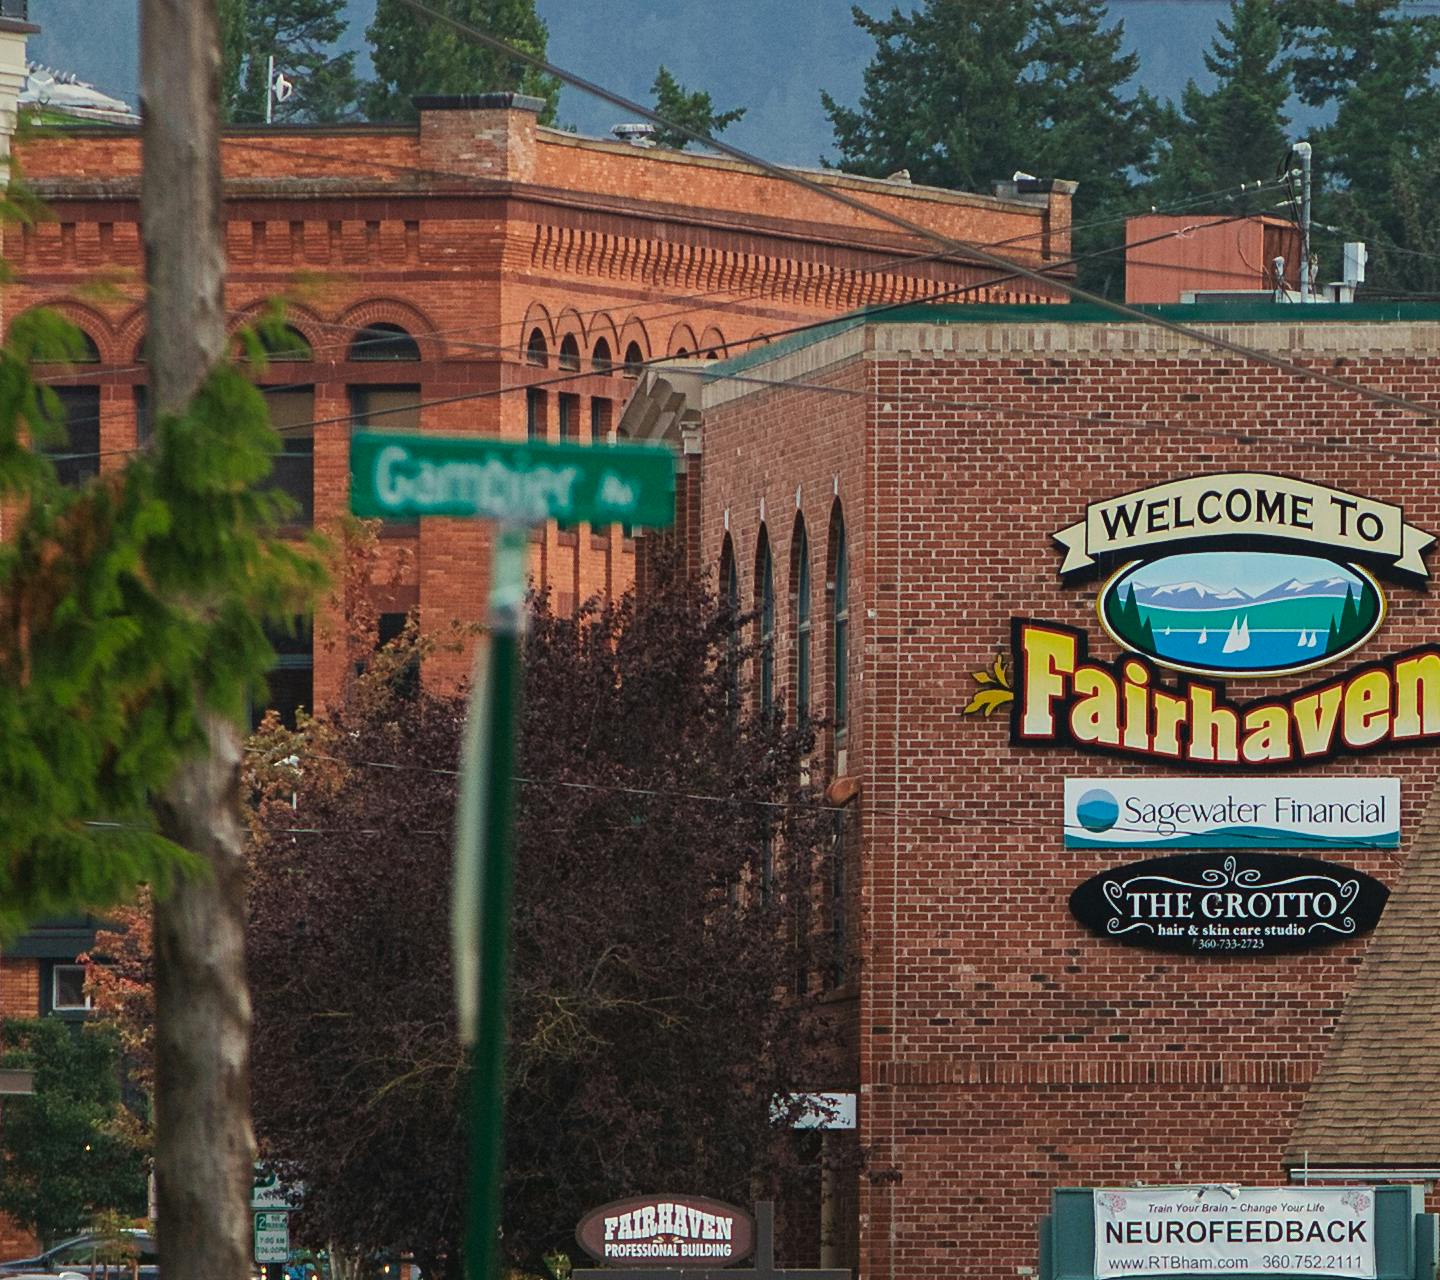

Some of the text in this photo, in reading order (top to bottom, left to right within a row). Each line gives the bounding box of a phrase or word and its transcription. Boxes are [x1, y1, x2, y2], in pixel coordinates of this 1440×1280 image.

[1100, 487, 1384, 542] WELCOME TO
[1125, 795, 1386, 836] Sagewater Financial
[1126, 892, 1337, 919] THE GROTTO
[1157, 924, 1306, 936] hair & skin care studio
[1198, 938, 1265, 949] 360-733-2723
[1148, 1203, 1173, 1213] Train
[1176, 1203, 1199, 1213] Your
[1202, 1203, 1228, 1213] Brain
[1240, 1203, 1278, 1215] Change
[1280, 1203, 1305, 1213] Your
[1306, 1203, 1325, 1213] Life
[604, 1202, 733, 1241] FAIRHAVEN
[1106, 1219, 1368, 1244] NEUROFEEDBACK
[605, 1243, 732, 1257] PROFESSIONAL BUILDING
[1108, 1255, 1362, 1270] www.RTBham.com 360.752.2111
